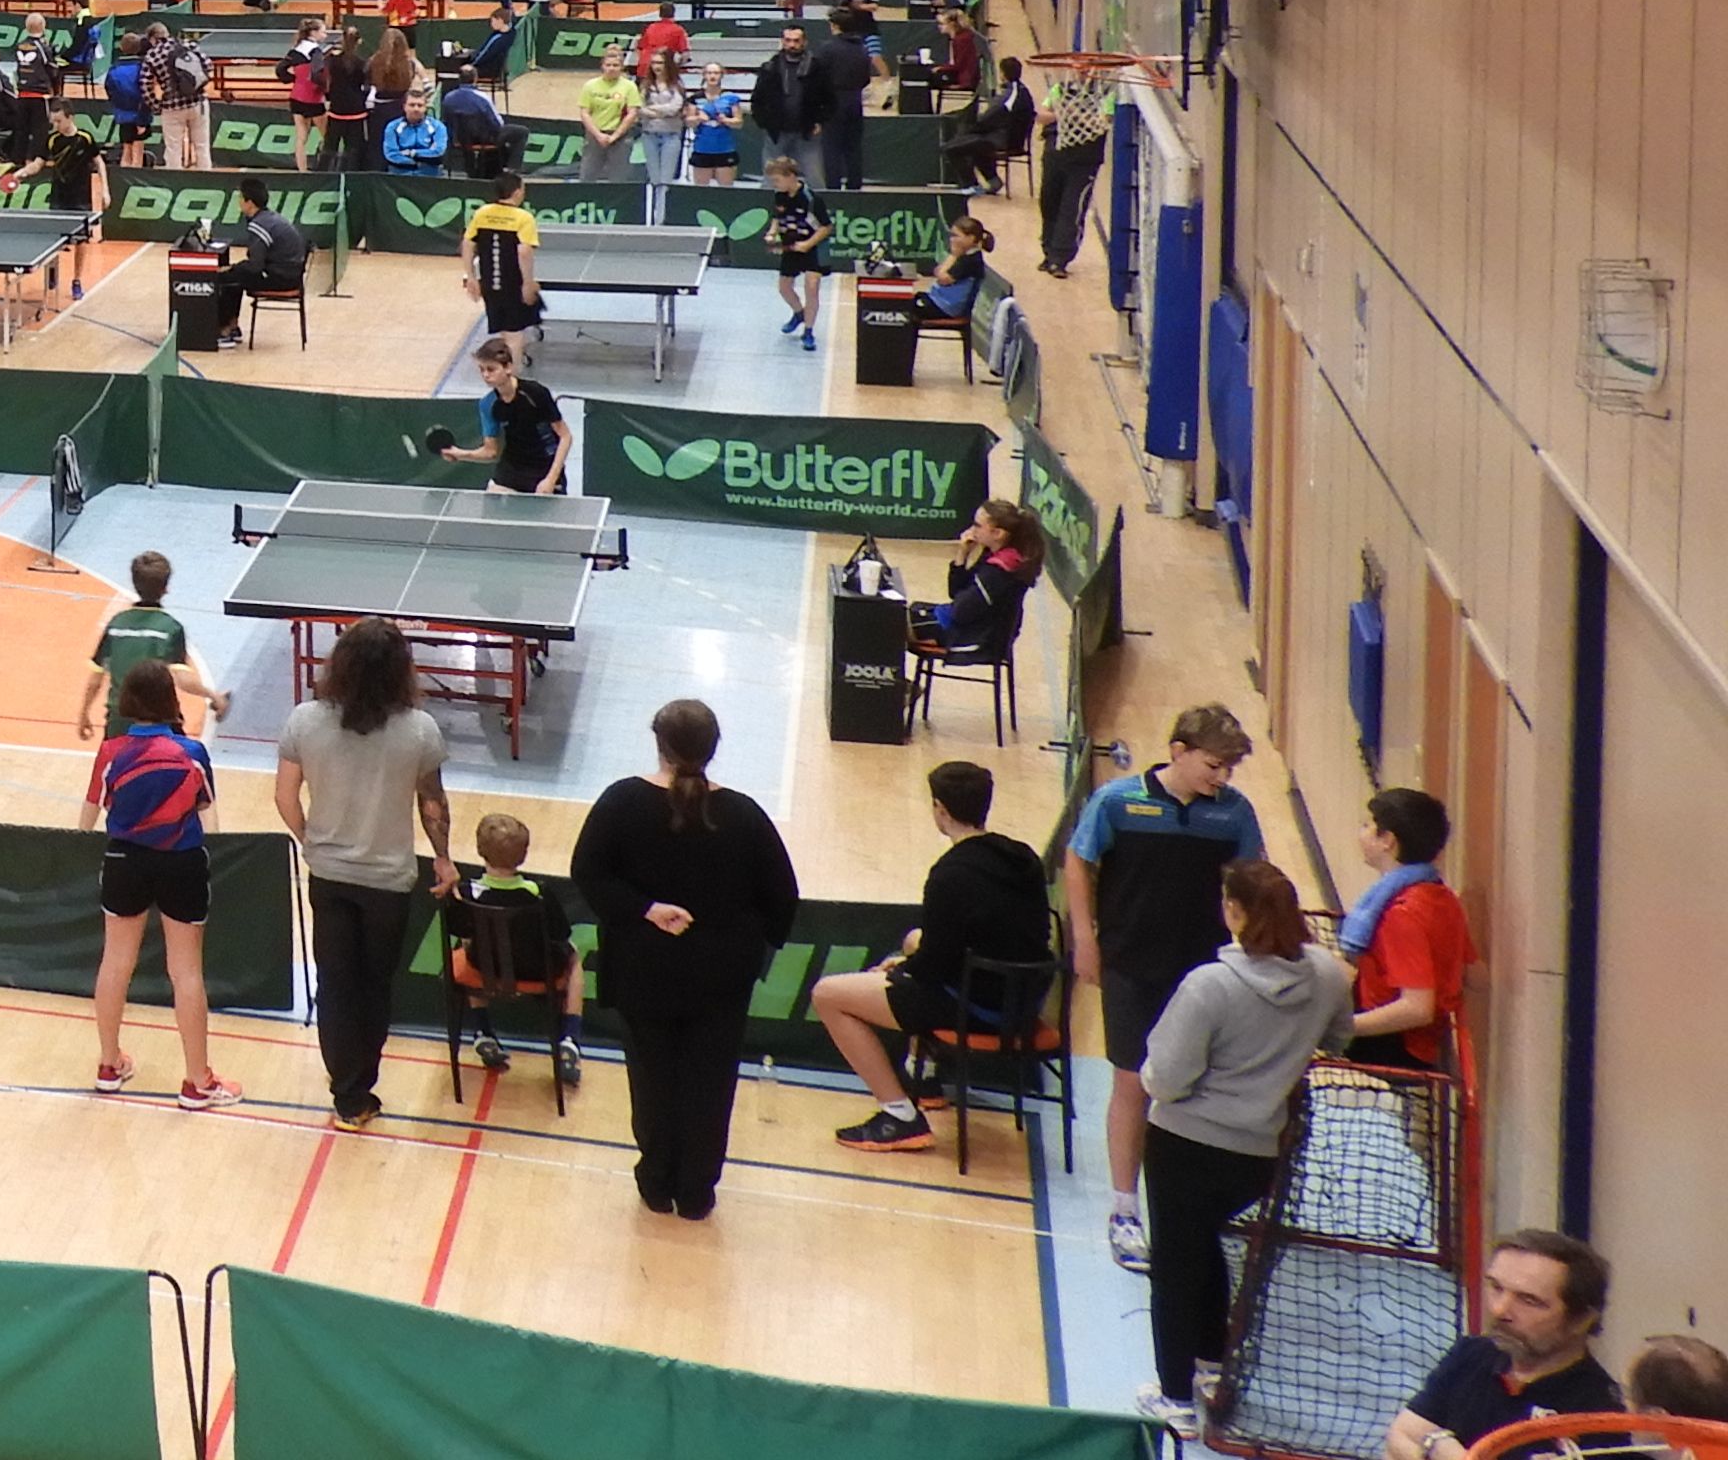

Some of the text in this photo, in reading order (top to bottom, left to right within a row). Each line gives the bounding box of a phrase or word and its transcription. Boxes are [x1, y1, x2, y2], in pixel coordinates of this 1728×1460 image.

[724, 439, 957, 508] Butterfly
[725, 492, 958, 520] www.butterfly-world.com
[844, 664, 896, 681] JOOLA
